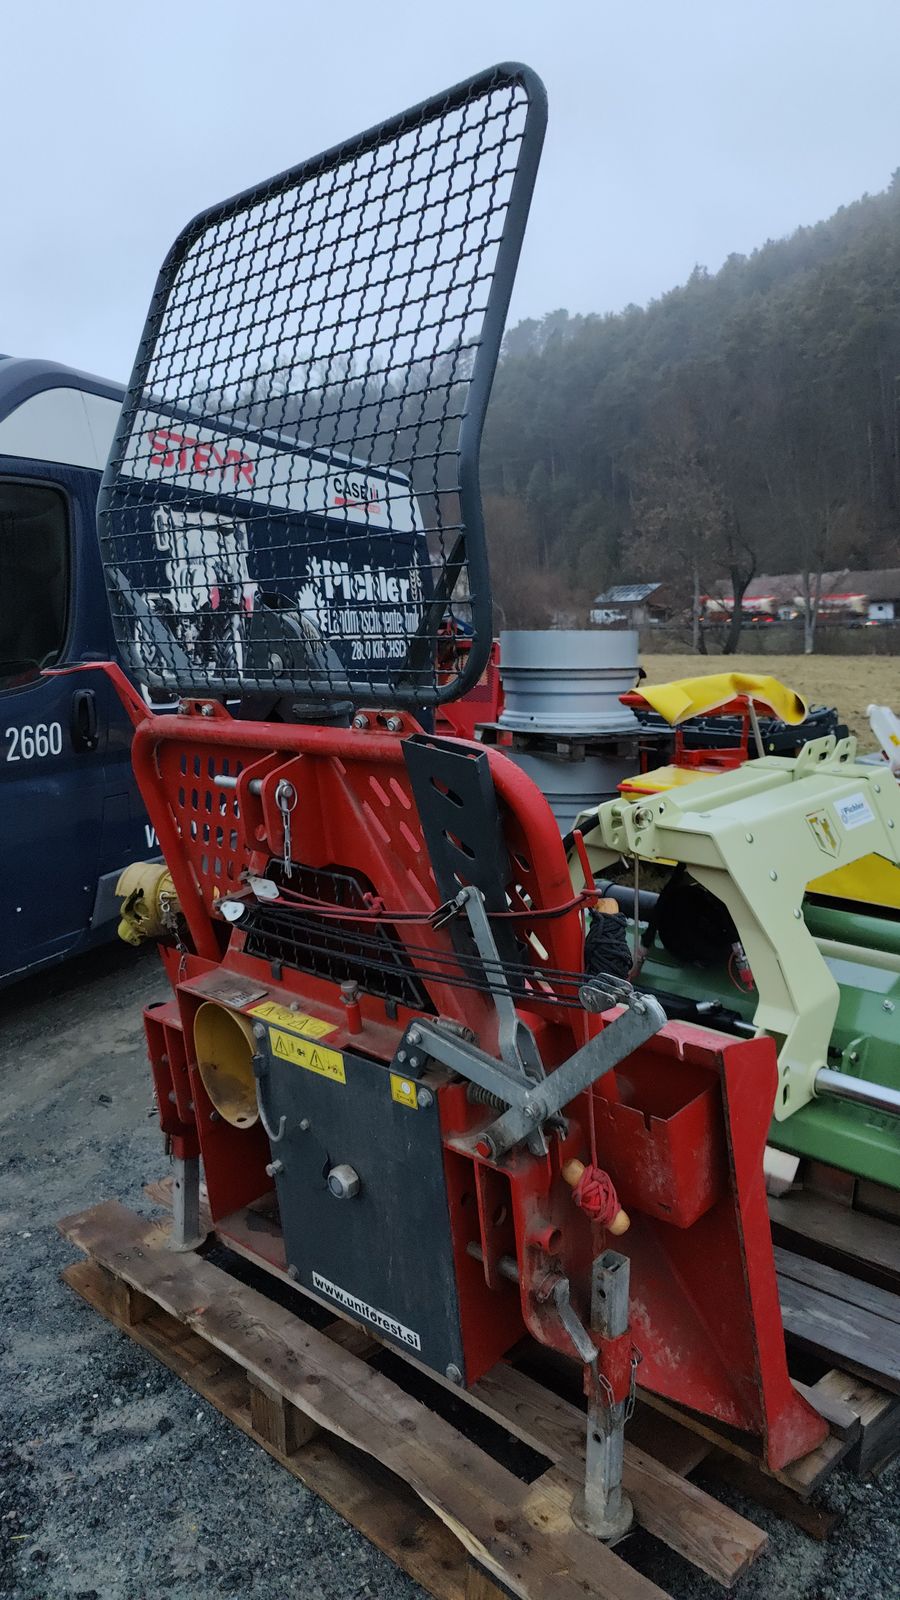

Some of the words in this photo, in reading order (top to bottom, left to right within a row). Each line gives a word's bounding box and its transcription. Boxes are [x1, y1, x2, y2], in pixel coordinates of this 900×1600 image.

[148, 429, 254, 486] STEYR
[333, 477, 367, 501] CASE
[322, 559, 410, 602] Pichler
[351, 640, 371, 660] 280
[5, 721, 63, 762] 2660
[314, 1276, 419, 1348] www.uniforest.si
